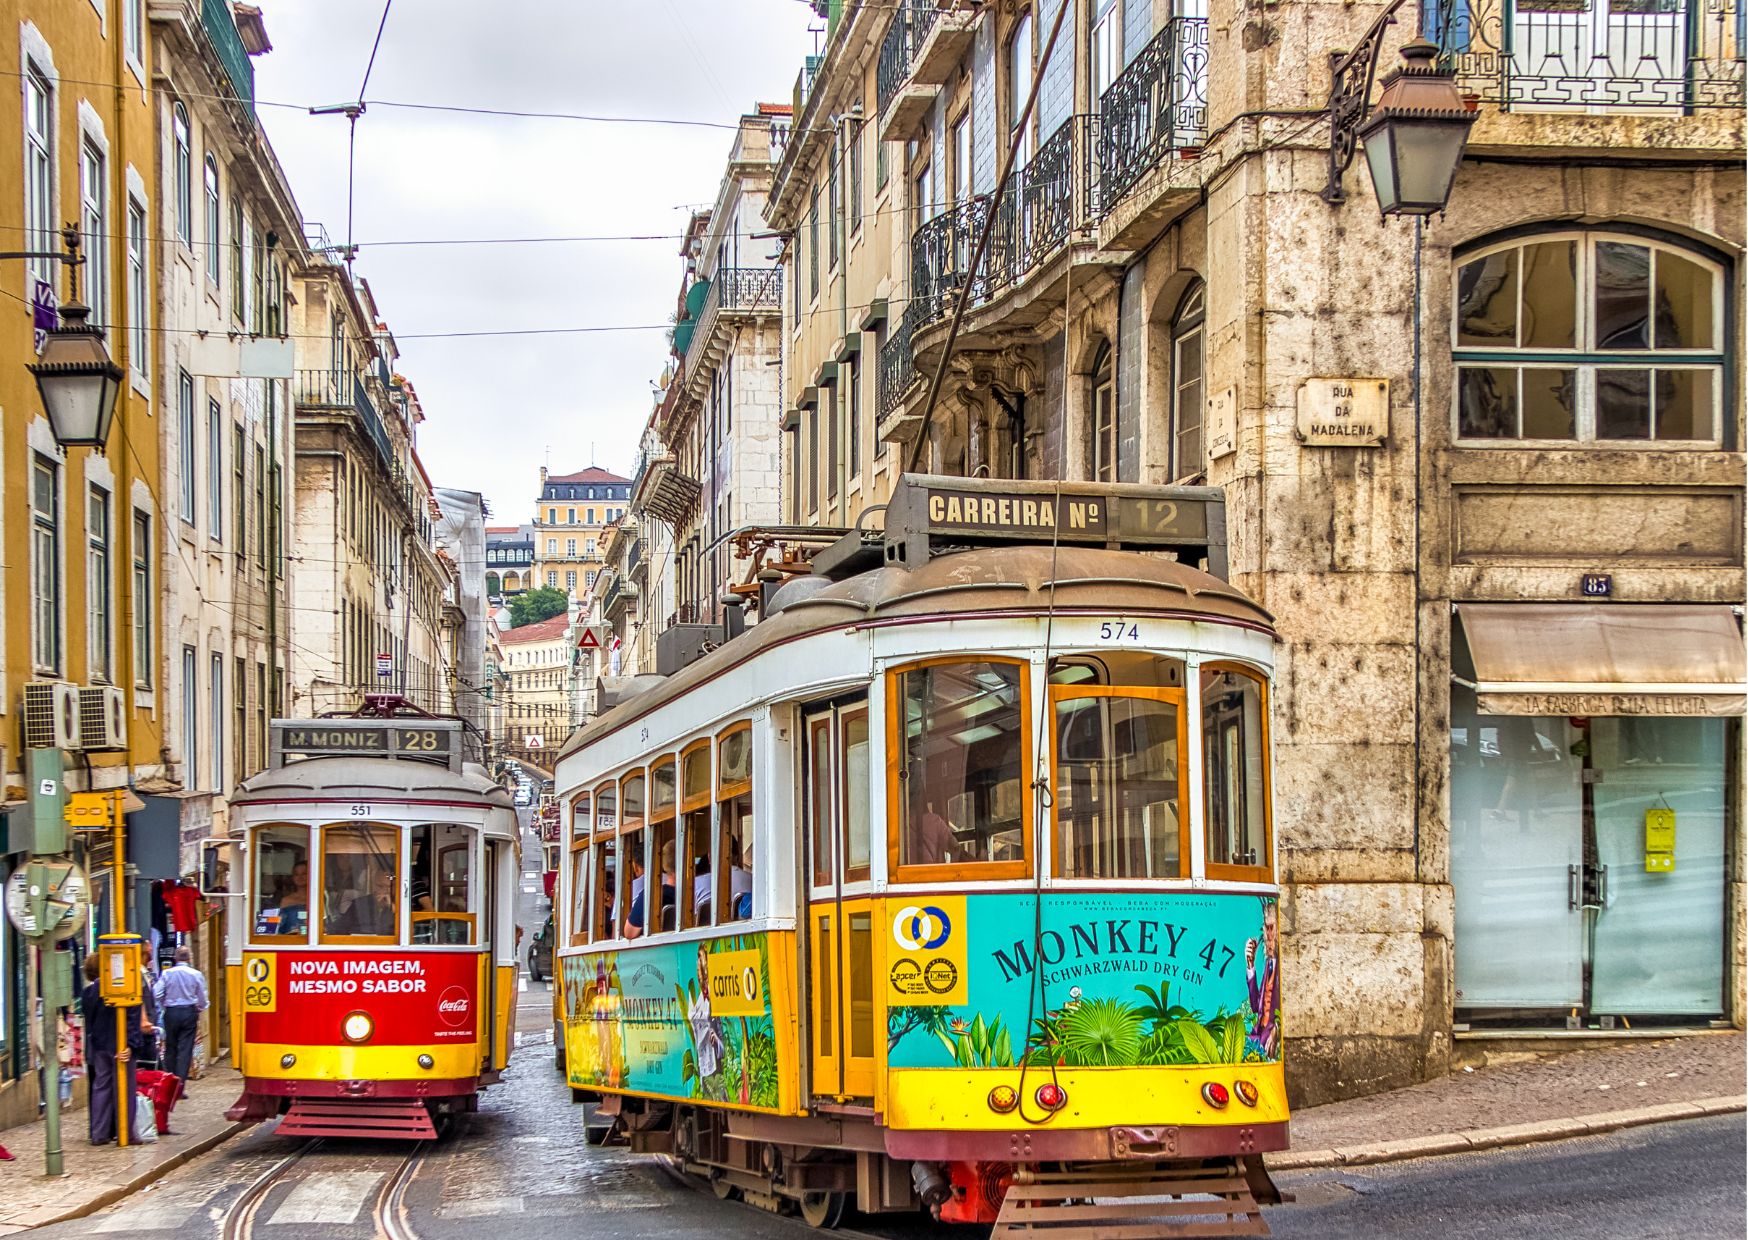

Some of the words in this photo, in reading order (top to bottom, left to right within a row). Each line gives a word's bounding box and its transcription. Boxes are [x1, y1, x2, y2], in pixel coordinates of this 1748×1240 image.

[1332, 387, 1354, 399] RUA
[1335, 406, 1350, 417] DA
[1311, 424, 1374, 436] MADALENA
[929, 495, 1055, 527] CARREIRA
[1135, 499, 1179, 534] 12
[1100, 622, 1139, 641] 574
[1546, 695, 1607, 714] FABBRICA
[289, 732, 308, 747] M.
[313, 732, 379, 747] MONIZ
[351, 805, 372, 816] 551
[991, 918, 1189, 984] MONKEY
[1198, 938, 1236, 978] 47
[290, 961, 339, 975] NOVA
[343, 960, 426, 976] IMAGEM,
[1043, 959, 1148, 987] SCHWARZWALD
[1153, 961, 1180, 977] DRY
[1183, 968, 1204, 985] GIN
[289, 980, 358, 993] MESMO
[361, 979, 426, 993] SABOR
[713, 966, 740, 998] carris
